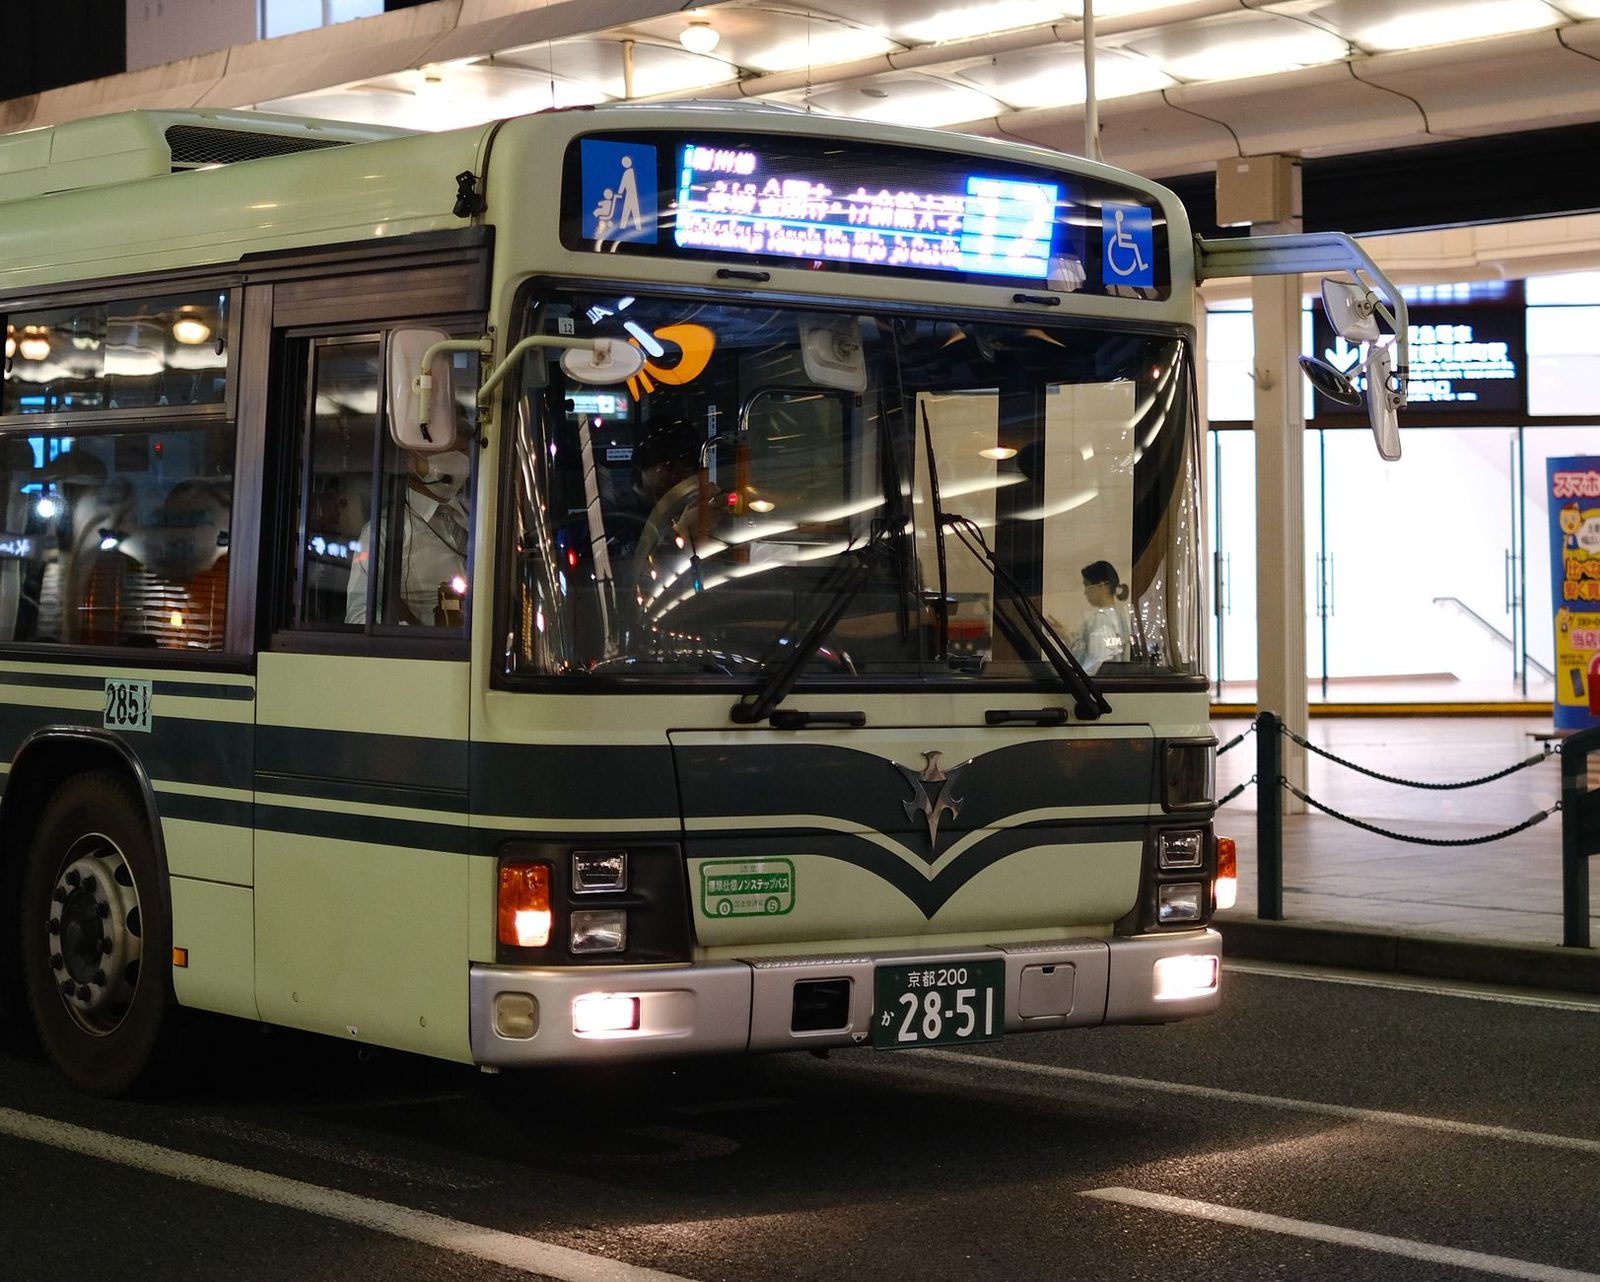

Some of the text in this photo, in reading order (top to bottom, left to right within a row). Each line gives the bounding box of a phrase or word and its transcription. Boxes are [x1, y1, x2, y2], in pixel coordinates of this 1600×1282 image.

[105, 683, 147, 727] 2851
[880, 987, 994, 1042] か 28-51
